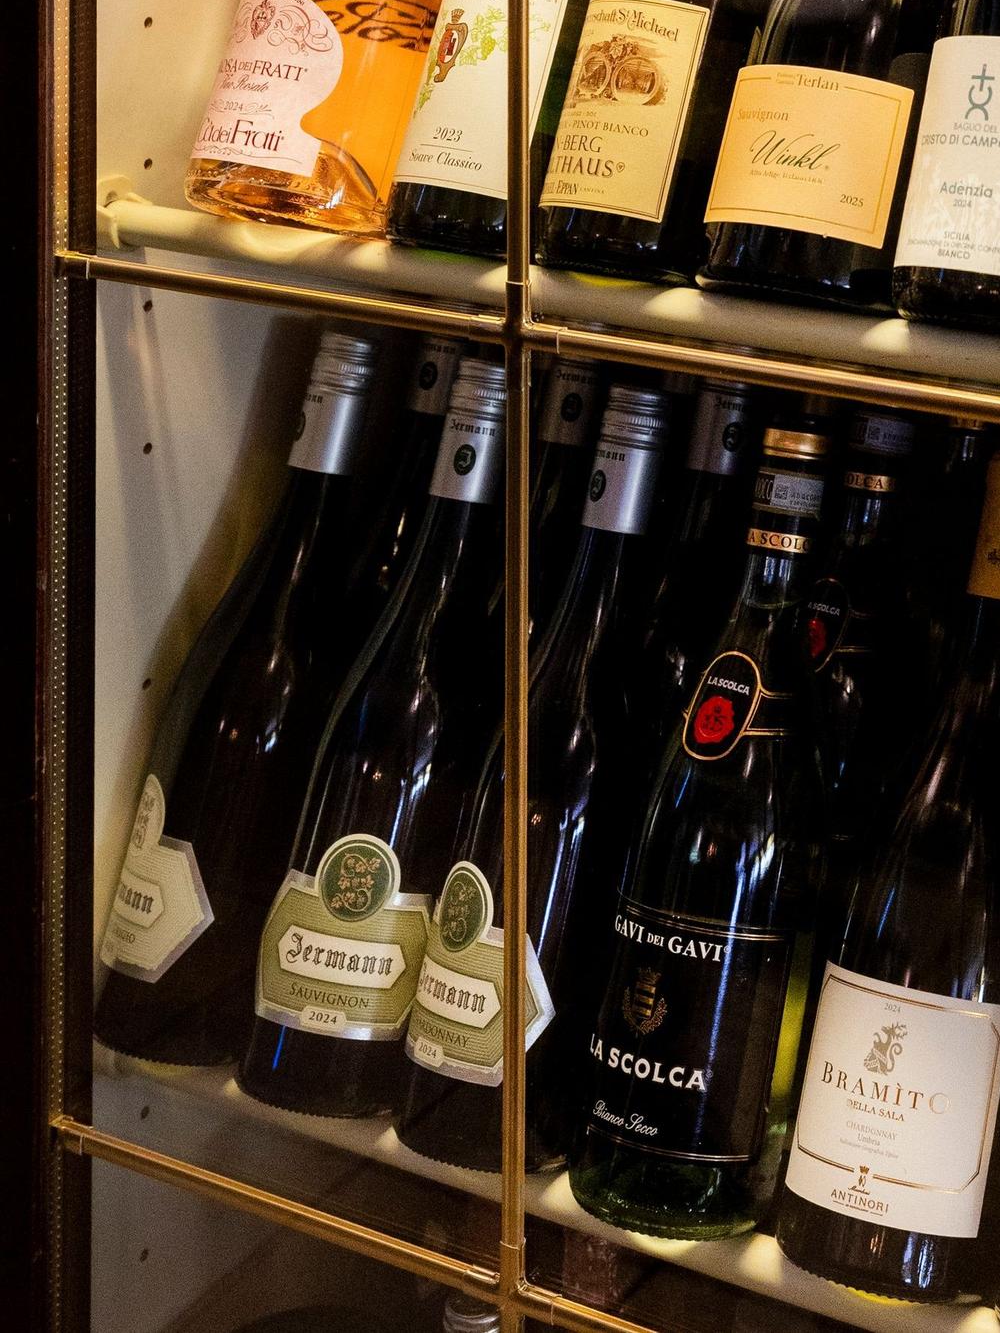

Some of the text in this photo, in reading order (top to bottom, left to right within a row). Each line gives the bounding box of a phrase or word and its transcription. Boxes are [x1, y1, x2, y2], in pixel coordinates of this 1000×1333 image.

[252, 59, 303, 81] FRATI
[796, 73, 840, 92] Terlan
[223, 101, 244, 111] 2024
[738, 108, 790, 122] Sauvignon
[432, 127, 464, 143] 2023
[572, 120, 649, 138] PINOT BIANCO
[983, 123, 998, 134] DEL
[949, 133, 959, 146] DI
[750, 130, 841, 171] Winkl
[436, 150, 483, 172] Classico
[943, 231, 970, 241] SICILIA
[937, 248, 971, 260] BIANCO
[707, 674, 750, 696] LA SCOLCA
[614, 915, 723, 963] GAVI DEI GAVI
[285, 931, 393, 977] Jermann
[289, 981, 370, 1009] SAUVIGNON
[308, 1010, 338, 1025] 2024
[418, 1041, 437, 1059] 2024
[589, 1033, 707, 1093] LA SCOLCA
[592, 1099, 659, 1138] Bianco Secco
[846, 1097, 905, 1122] DELLA SALA
[846, 1120, 898, 1141] CHARDONNAY
[857, 1133, 881, 1146] Umbria
[831, 1189, 889, 1214] ANTINORI
